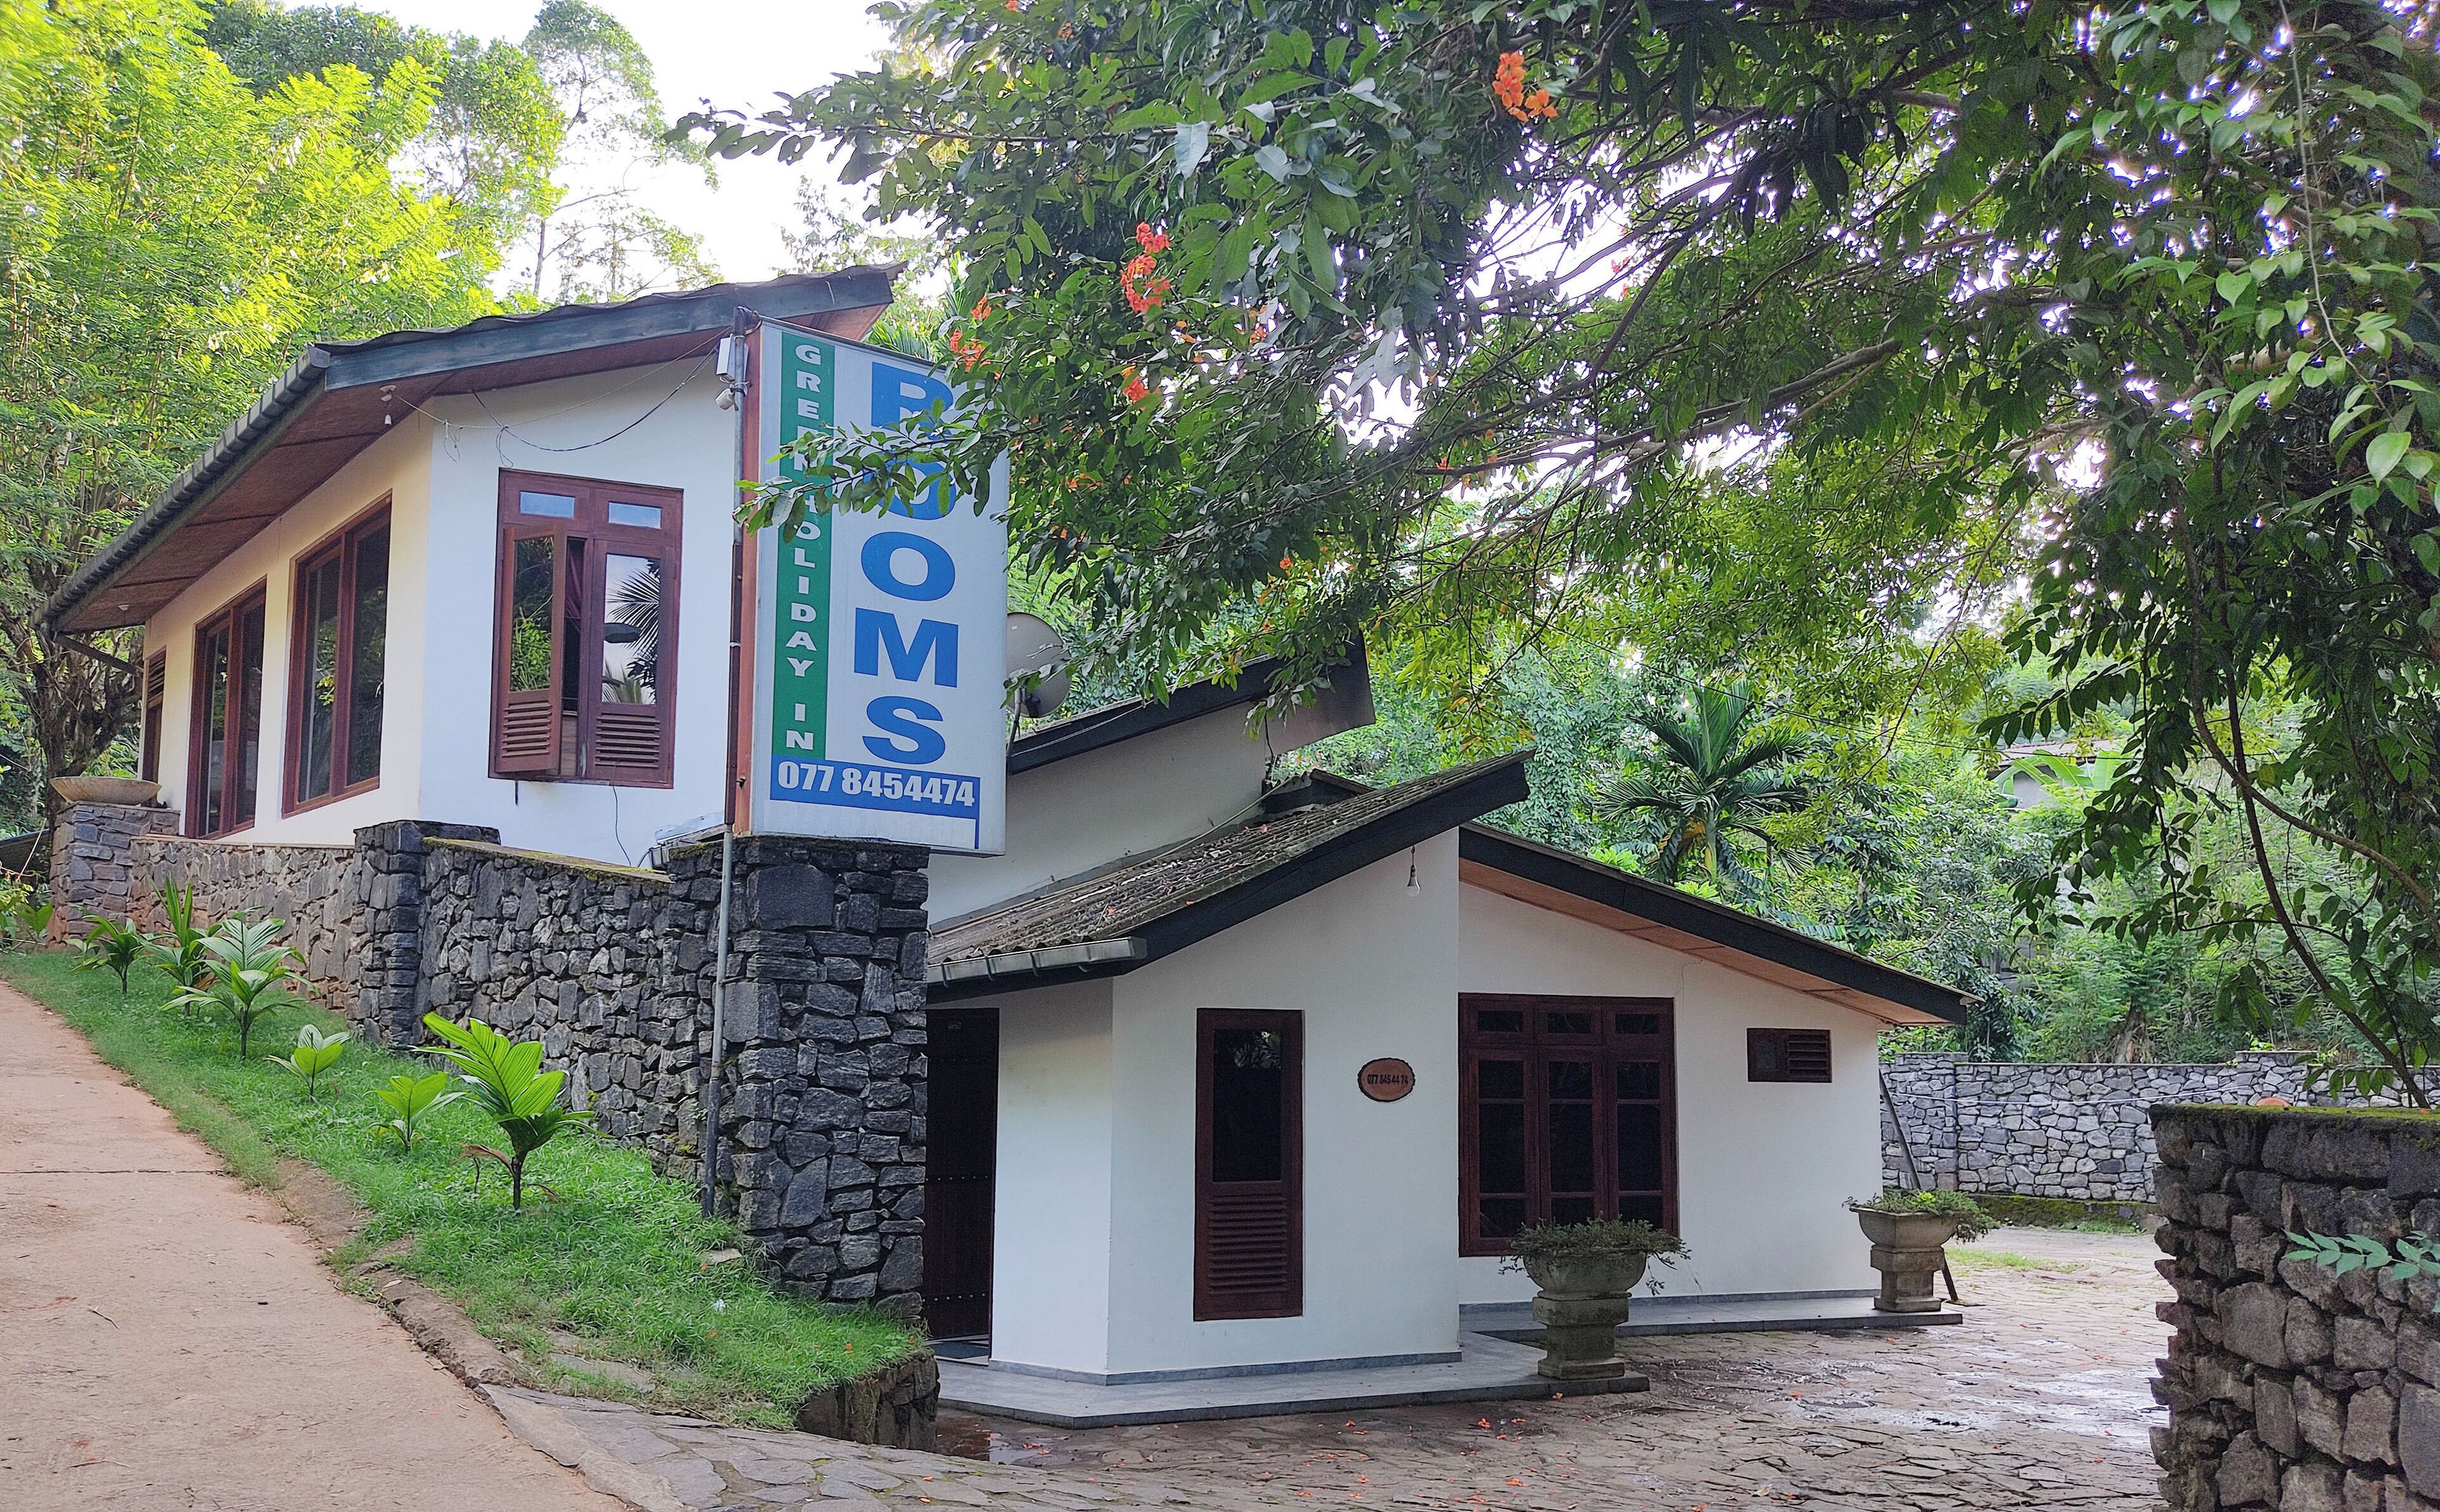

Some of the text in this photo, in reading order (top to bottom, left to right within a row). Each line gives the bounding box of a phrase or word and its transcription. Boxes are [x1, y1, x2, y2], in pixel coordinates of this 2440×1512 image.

[853, 361, 959, 765] ROOMS
[785, 703, 814, 751] IN
[778, 760, 975, 807] 077 8454474
[1367, 1074, 1378, 1084] 077
